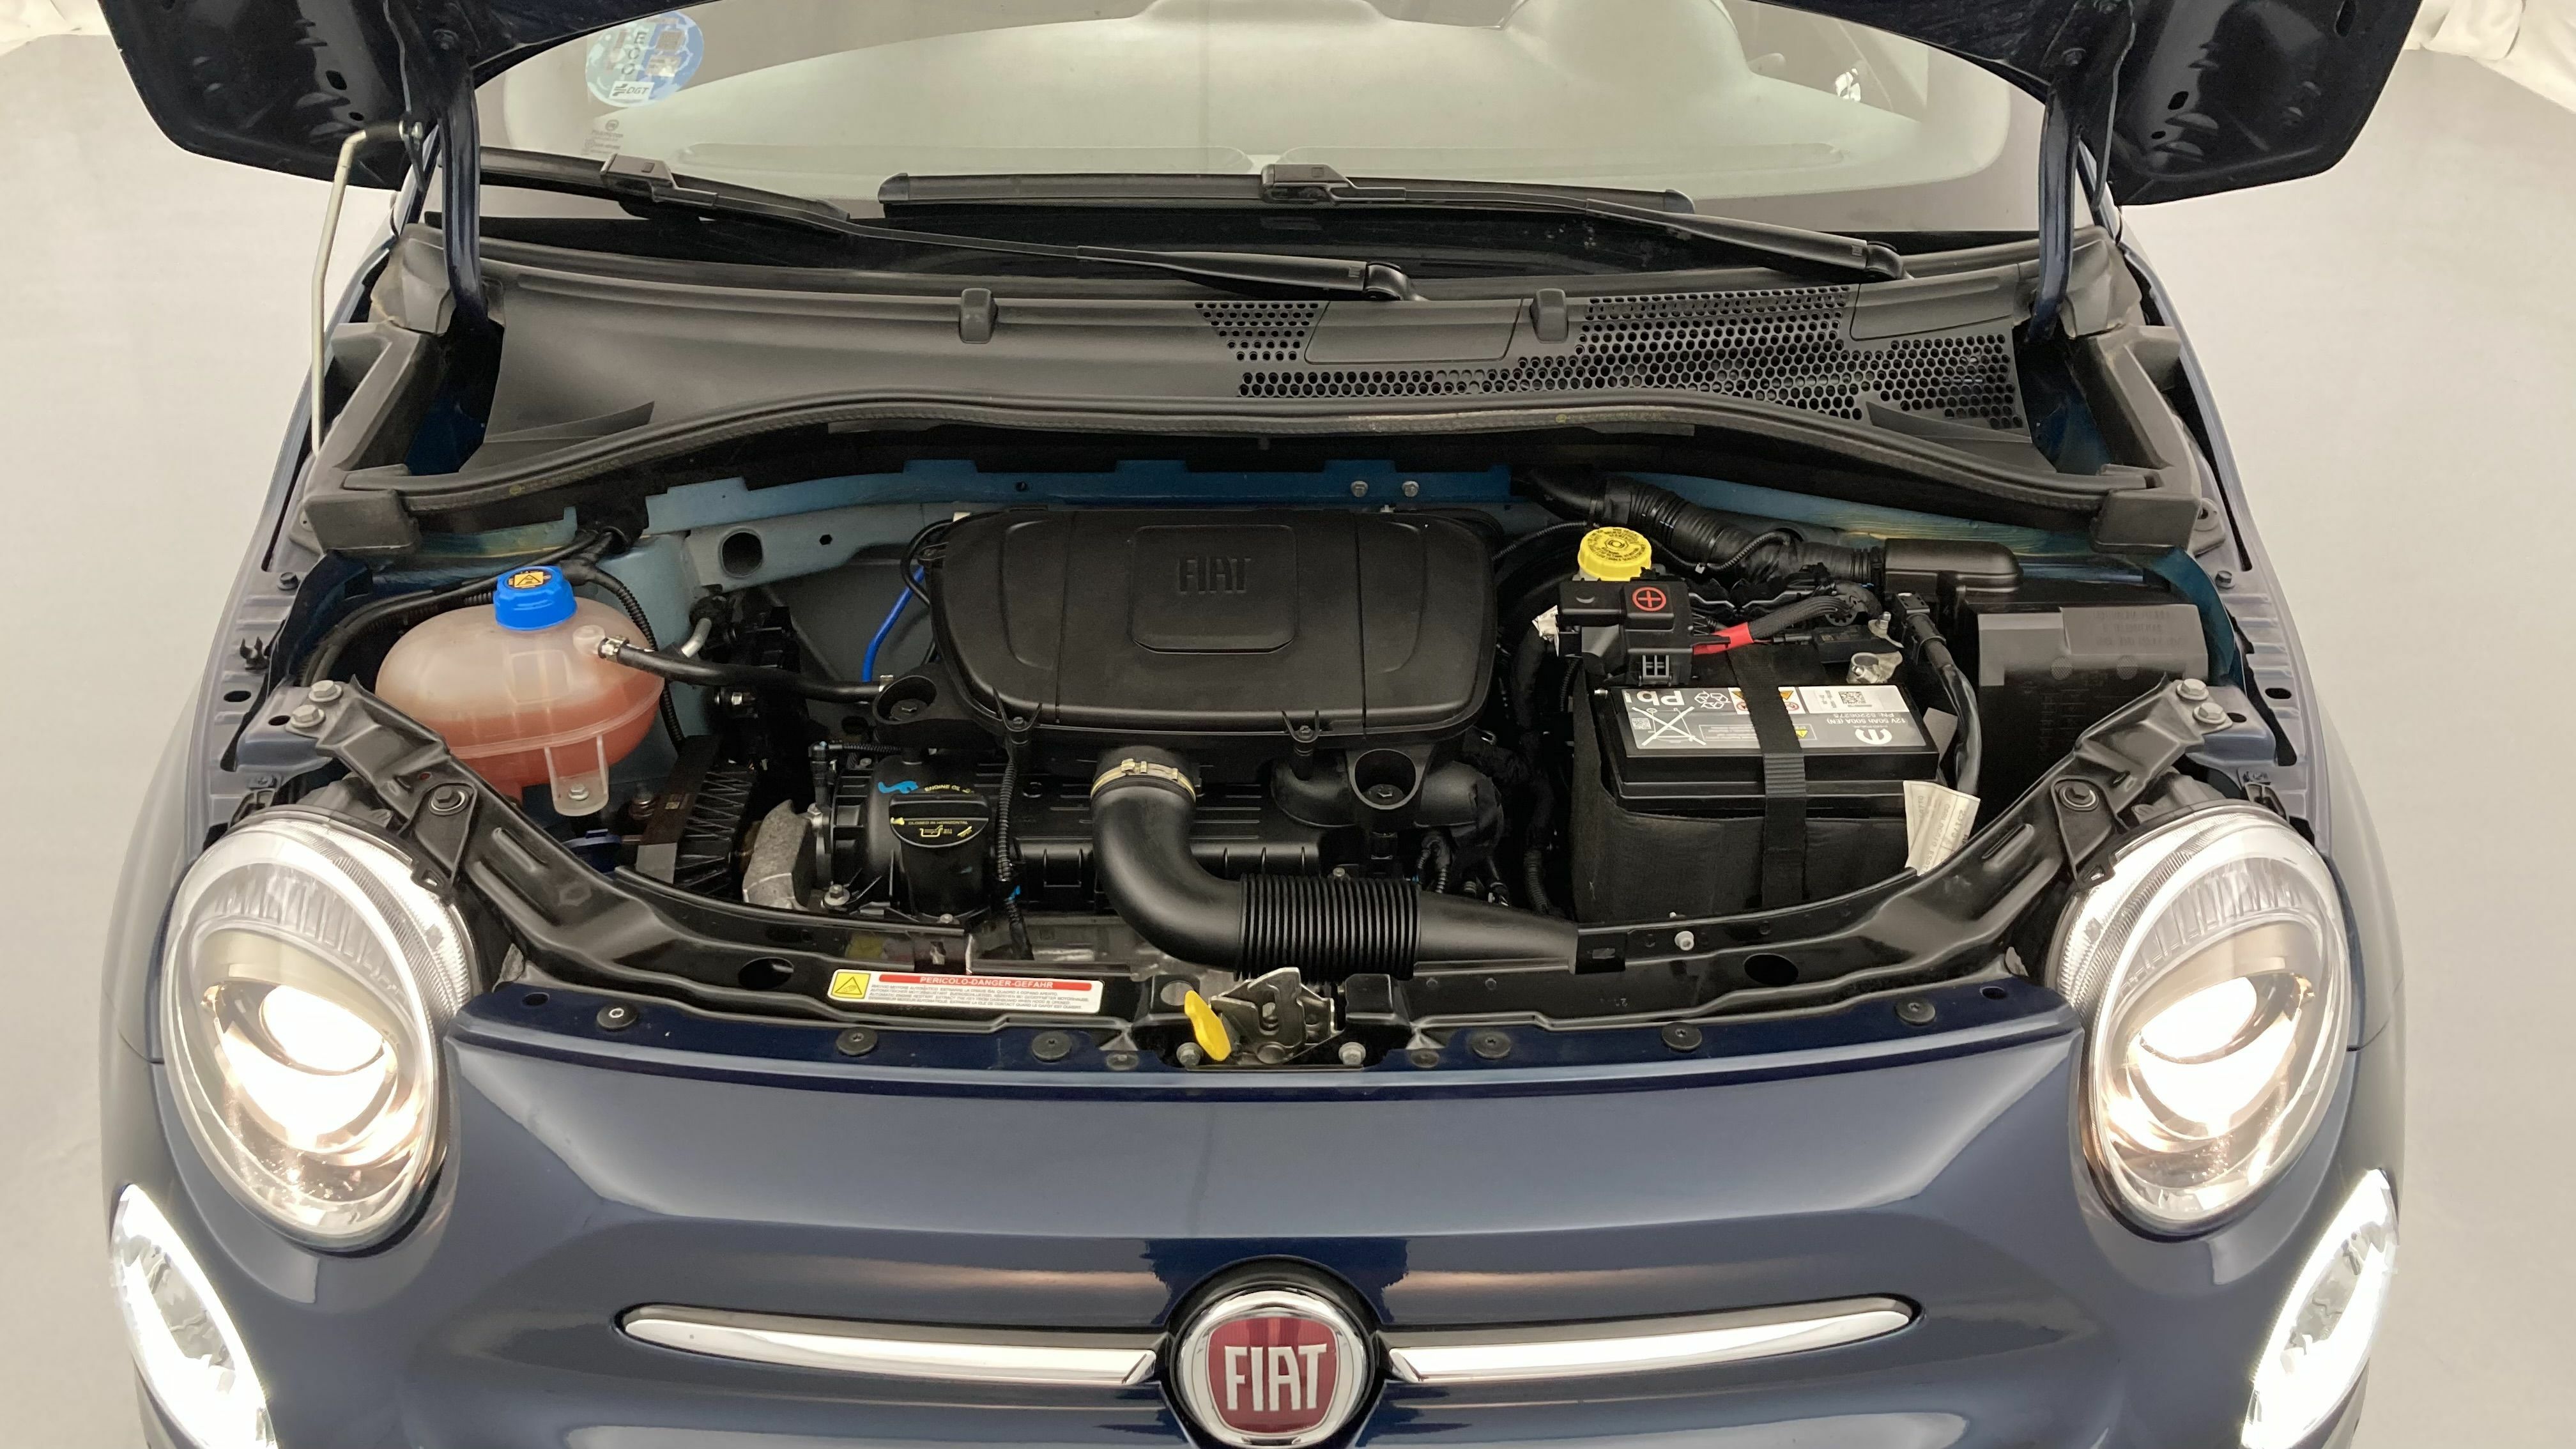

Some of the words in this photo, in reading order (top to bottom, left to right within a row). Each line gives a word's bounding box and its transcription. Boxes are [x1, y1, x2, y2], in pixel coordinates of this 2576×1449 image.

[1176, 556, 1251, 595] FIAT
[1637, 690, 1685, 706] Pb
[919, 976, 1054, 989] PERICOLO-DANGER-GEFAHR
[1225, 1344, 1327, 1411] FIAT
